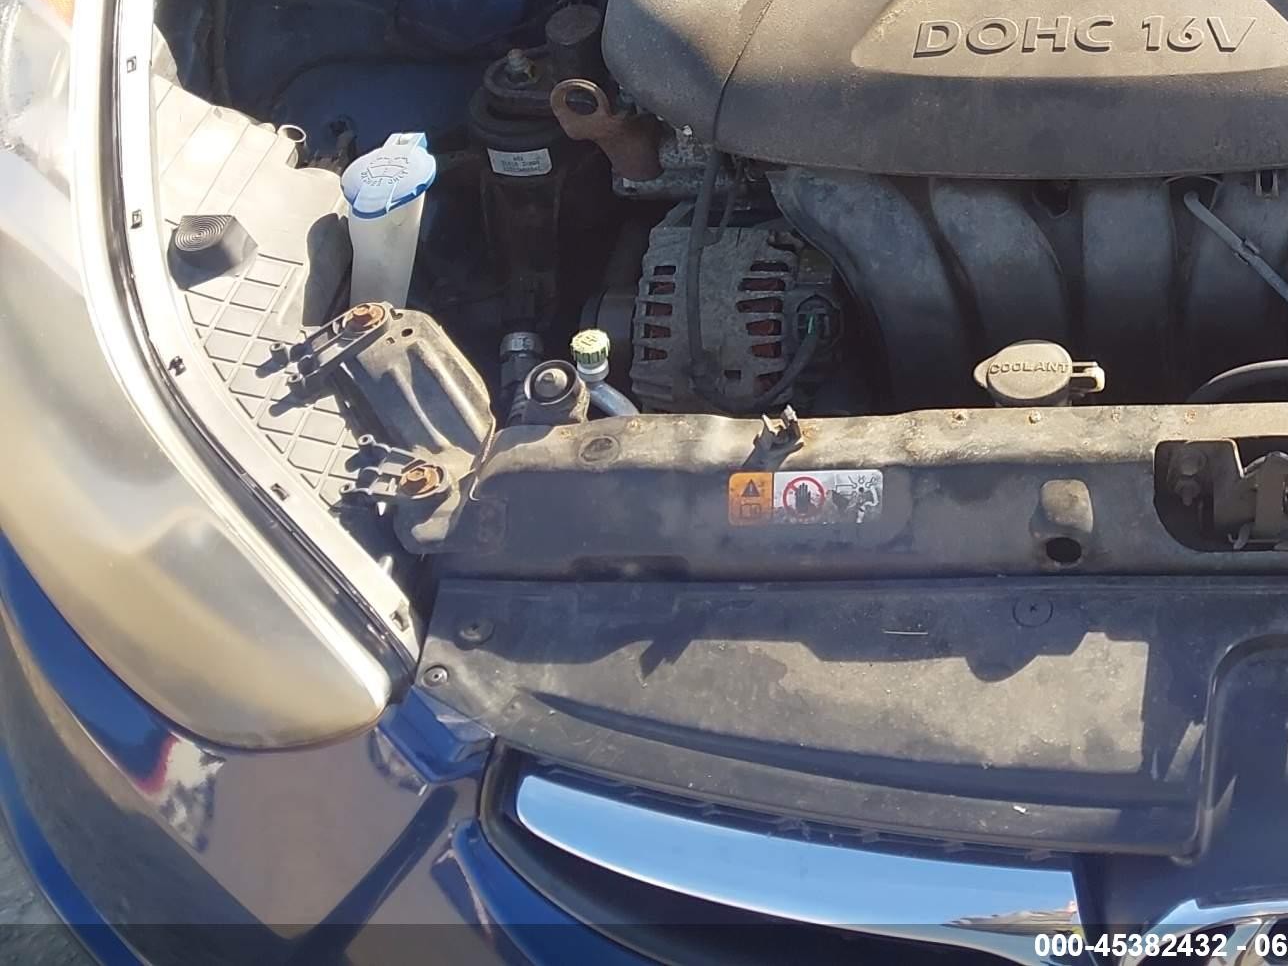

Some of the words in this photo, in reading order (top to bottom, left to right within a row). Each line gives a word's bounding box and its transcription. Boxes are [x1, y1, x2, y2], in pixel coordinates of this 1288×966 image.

[913, 15, 1114, 59] DOHC
[1141, 16, 1257, 53] 16V
[989, 361, 1069, 375] COOLANT
